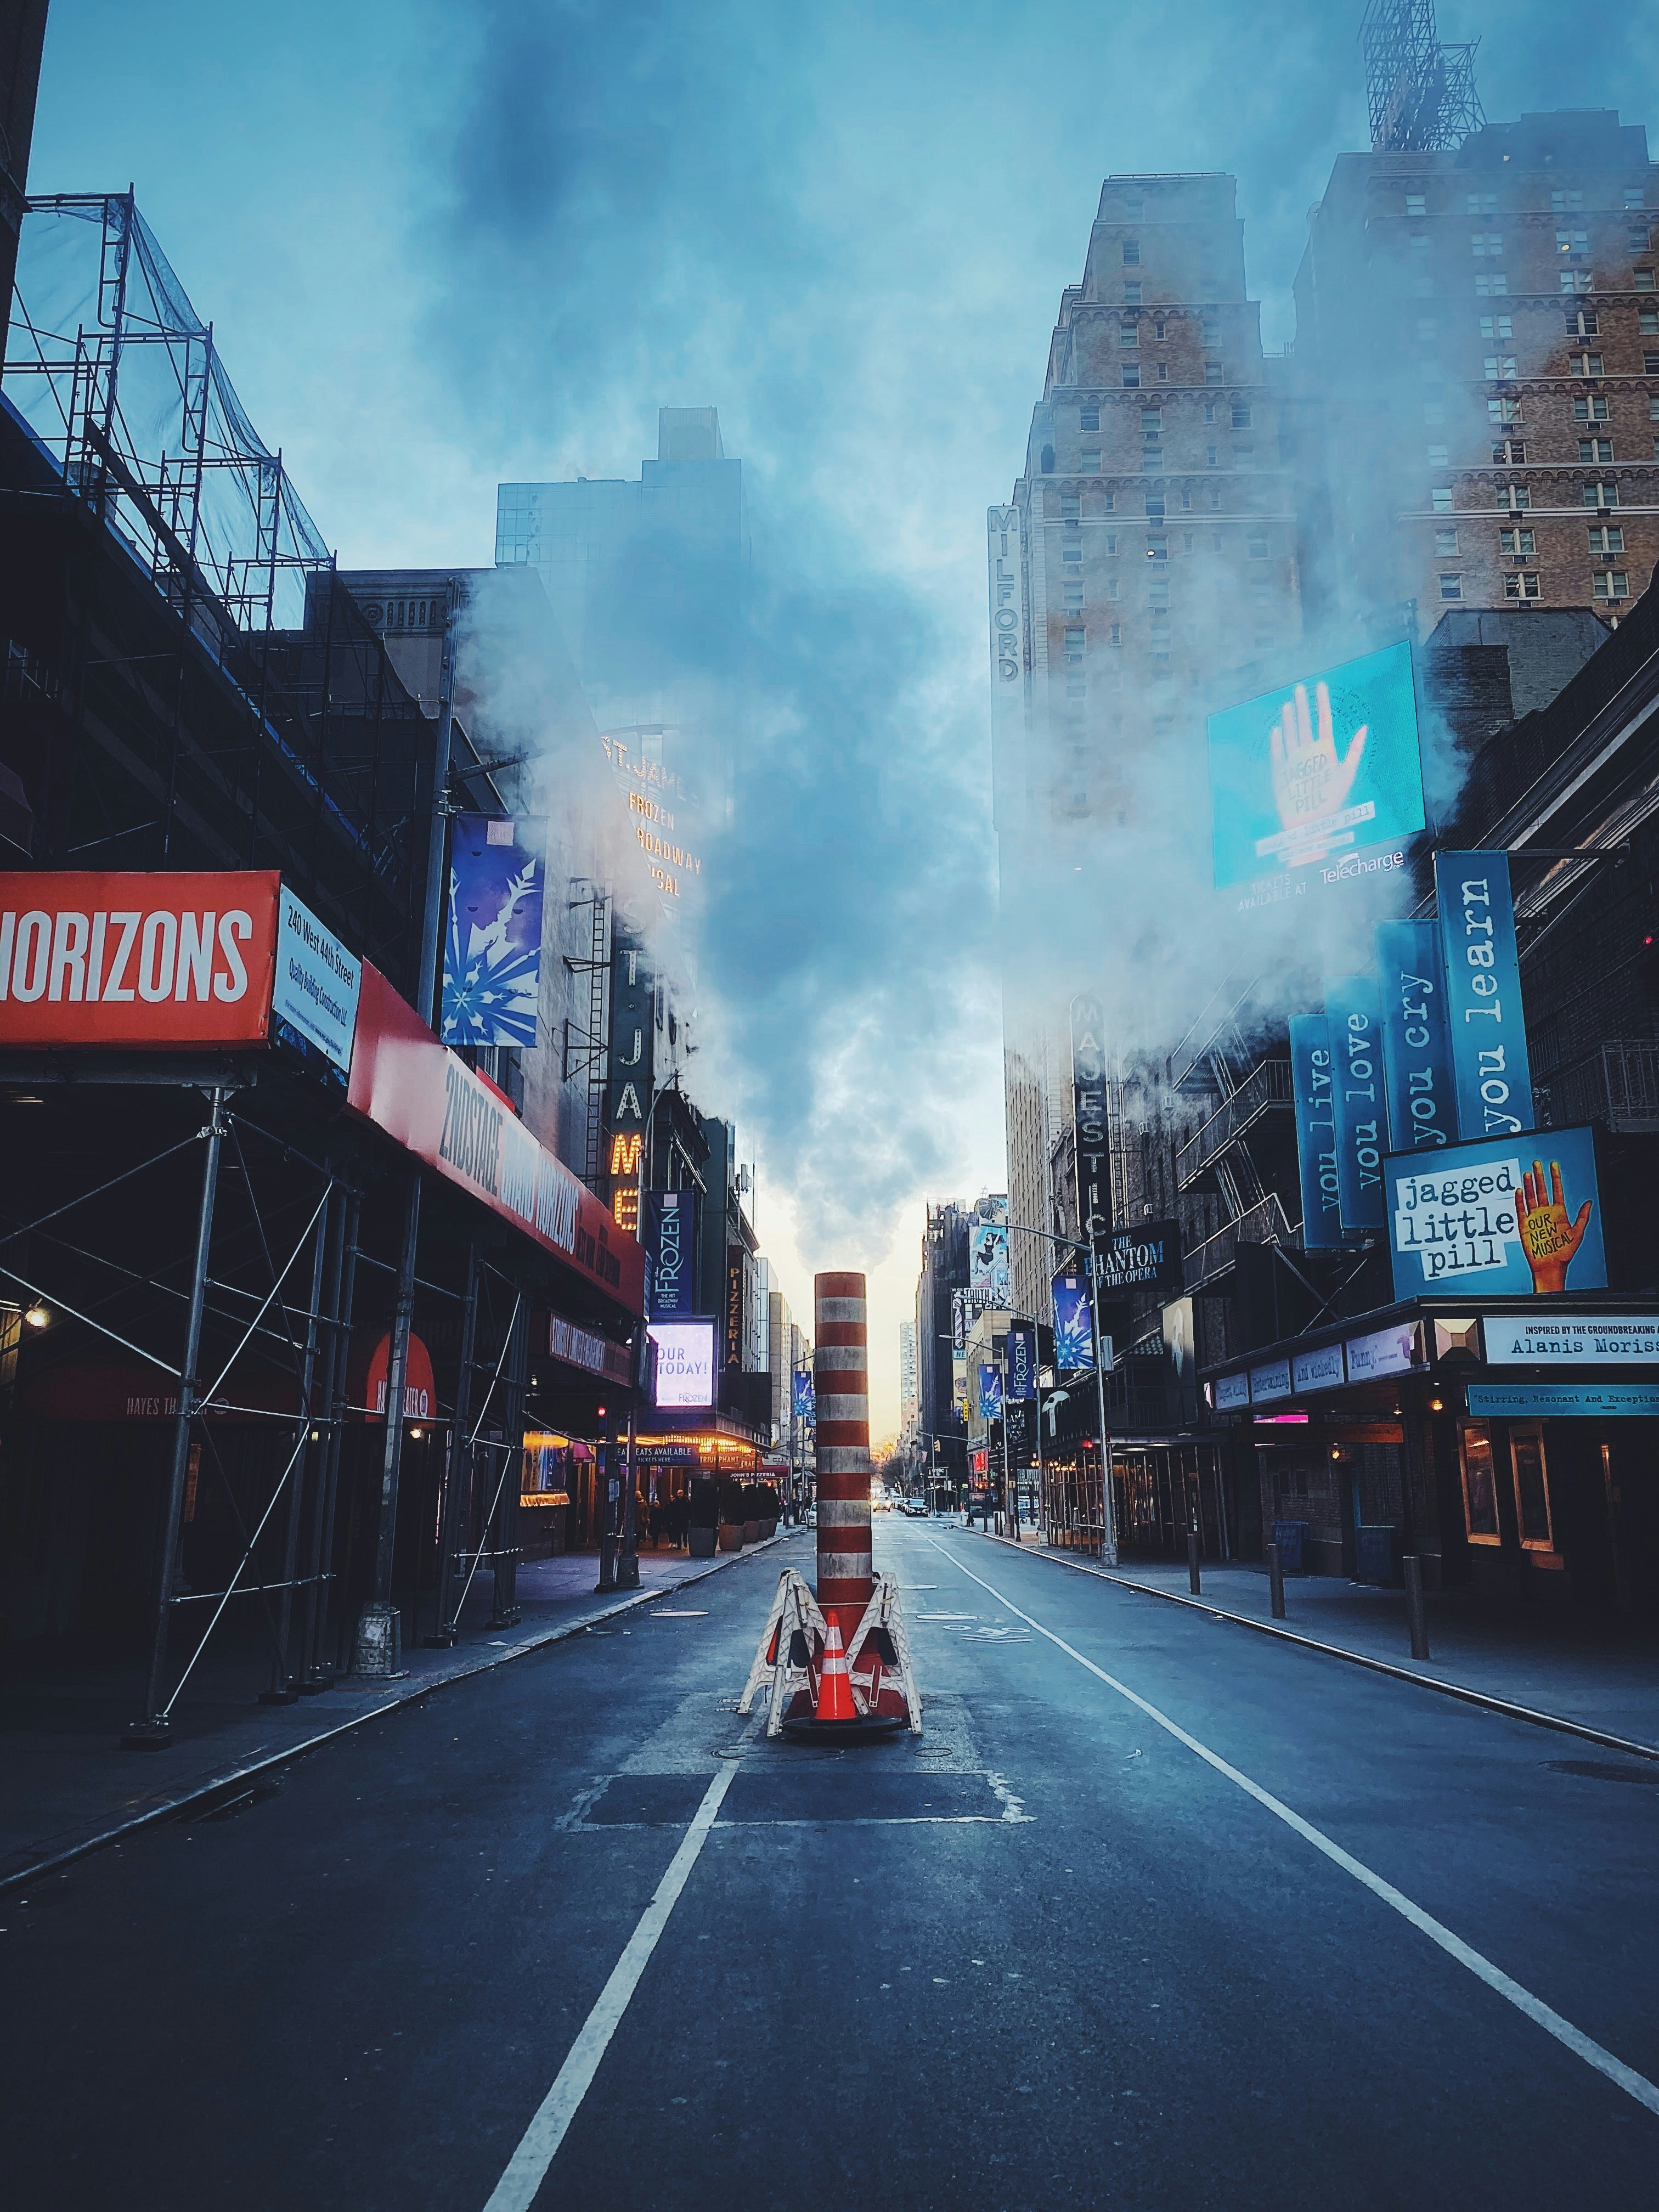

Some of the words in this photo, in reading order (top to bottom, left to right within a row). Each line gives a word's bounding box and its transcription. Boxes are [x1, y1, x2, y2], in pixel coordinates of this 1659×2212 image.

[990, 509, 1019, 682] MILFORD
[629, 791, 674, 831] FROZEN
[636, 828, 701, 874] ROADWAY
[1319, 851, 1404, 884] Telecharge
[1295, 882, 1307, 895] AT
[288, 905, 301, 935] 240
[303, 919, 319, 955] West
[320, 939, 334, 970] 44th
[335, 953, 354, 989] Street
[1465, 878, 1502, 1023] learn
[290, 957, 304, 991] Quality
[303, 971, 319, 1005] Building
[319, 986, 341, 1022] Construction
[1401, 970, 1434, 1048] cry
[1346, 1013, 1375, 1102] love
[1308, 1049, 1334, 1132] live
[1409, 1066, 1447, 1145] you
[1479, 1045, 1522, 1133] you
[1075, 1003, 1107, 1236] MAJESTIC
[1356, 1120, 1381, 1190] you
[1319, 1151, 1339, 1212] you
[1406, 1166, 1515, 1210] jagged
[535, 1158, 579, 1255] HORIZONS
[1403, 1207, 1514, 1245] little
[1528, 1213, 1551, 1231] OUR
[654, 1208, 684, 1293] FROZEN
[1112, 1235, 1132, 1250] THE
[1530, 1221, 1558, 1247] NEW
[1531, 1232, 1574, 1260] MUSICAL
[1105, 1272, 1124, 1286] THE
[1125, 1266, 1157, 1283] OPERA
[1427, 1239, 1501, 1278] pill
[728, 1268, 740, 1363] PIZZERIA
[1525, 1326, 1560, 1335] INSPIRED
[1562, 1326, 1571, 1335] BY
[1572, 1326, 1587, 1335] THE
[1588, 1325, 1656, 1334] GROUNDBREAKING
[659, 1362, 707, 1374] TODAY!
[1014, 1341, 1029, 1387] FROZEN
[1511, 1339, 1583, 1353] Alanis
[127, 1397, 160, 1415] HAYES
[679, 1392, 707, 1403] FROZEN
[1533, 1395, 1579, 1403] Resonant
[1585, 1395, 1602, 1403] And
[654, 1447, 691, 1455] AVAILABLE
